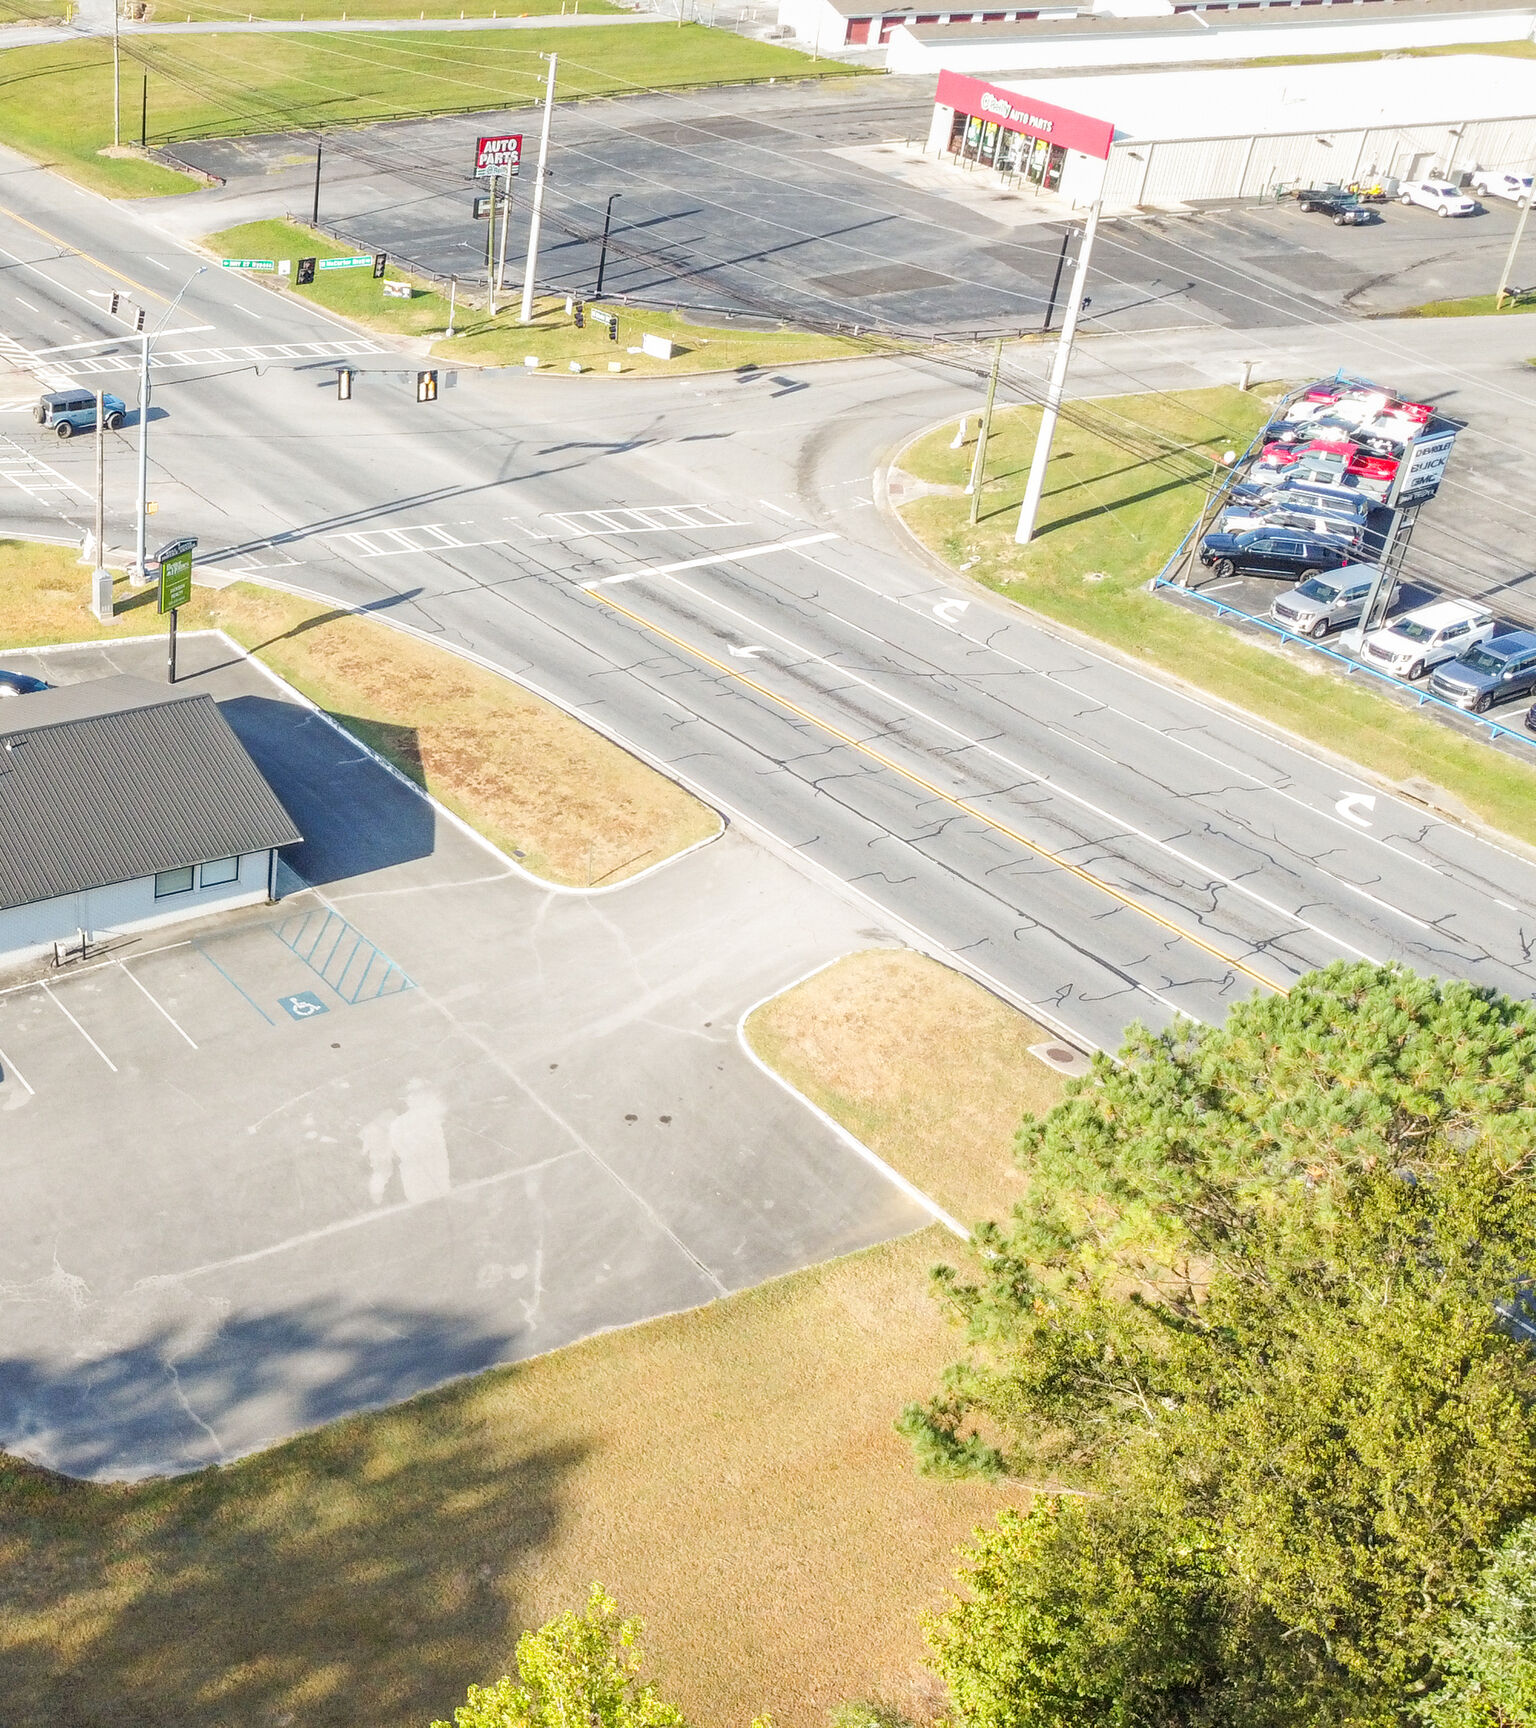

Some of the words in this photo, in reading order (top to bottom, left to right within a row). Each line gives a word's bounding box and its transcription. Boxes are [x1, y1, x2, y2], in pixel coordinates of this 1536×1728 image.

[1009, 109, 1030, 125] AUTO
[1028, 115, 1053, 133] PARTS
[484, 139, 518, 153] AUTO
[479, 151, 519, 166] PARTS
[1410, 456, 1448, 473] BUICK
[1411, 473, 1438, 487] GMC
